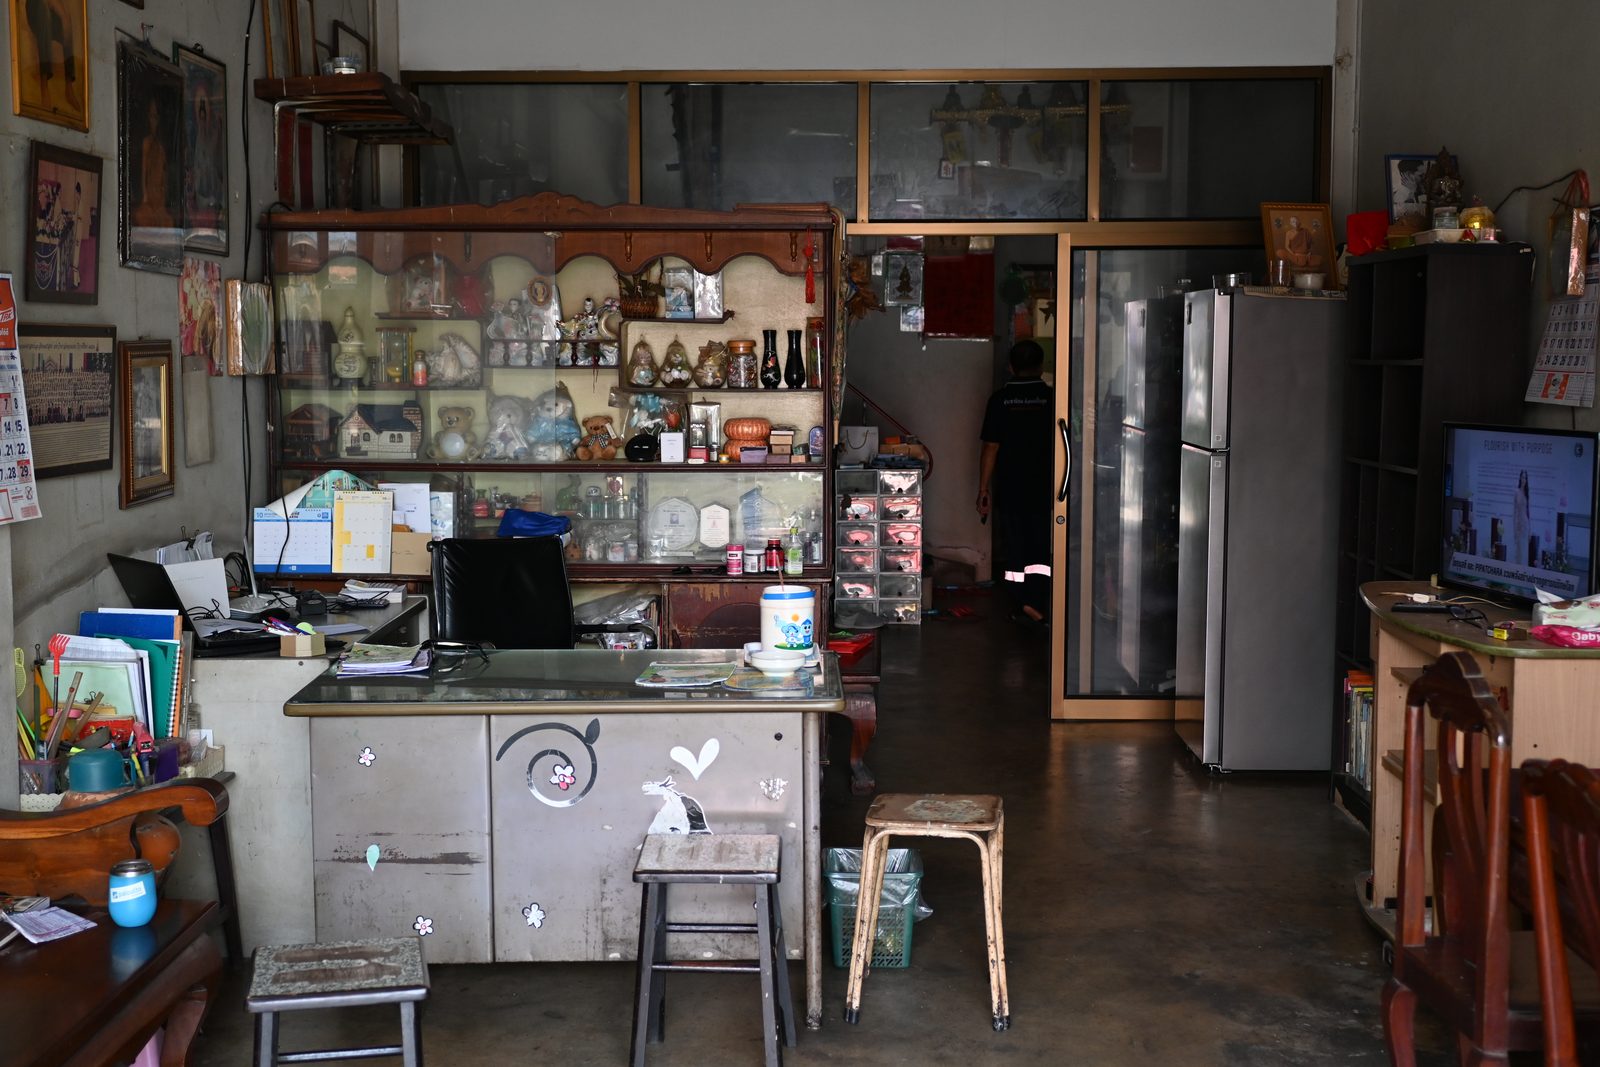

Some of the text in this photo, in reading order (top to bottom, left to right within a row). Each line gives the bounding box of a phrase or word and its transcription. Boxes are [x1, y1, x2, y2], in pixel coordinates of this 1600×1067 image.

[4, 397, 18, 410] 7 8
[4, 420, 23, 433] 14 15
[6, 443, 26, 456] 21 22
[8, 467, 17, 479] 28
[20, 465, 29, 478] 29
